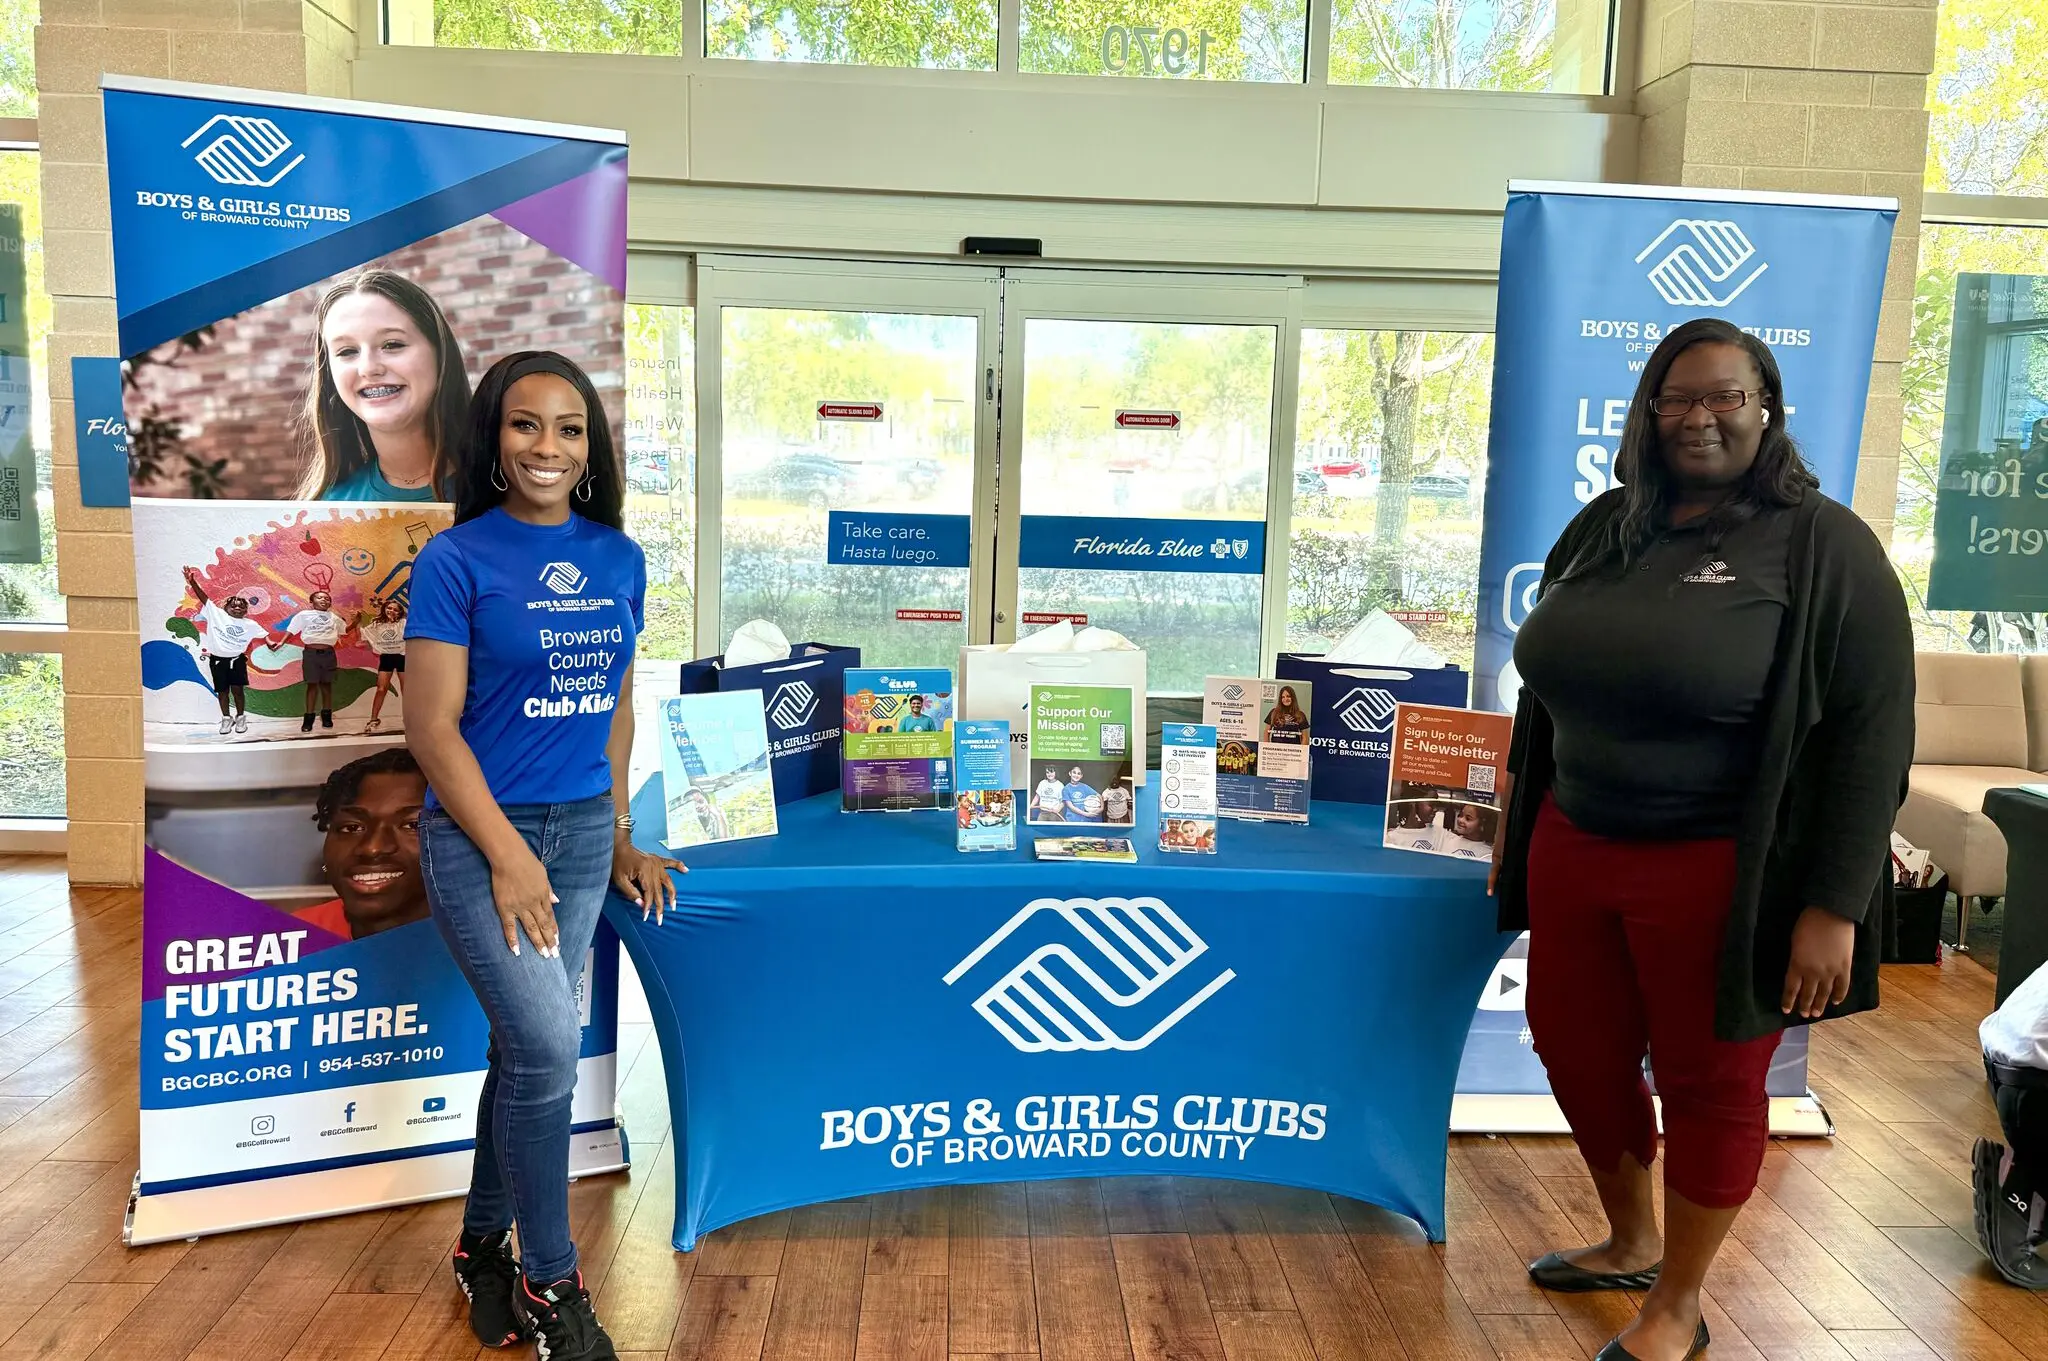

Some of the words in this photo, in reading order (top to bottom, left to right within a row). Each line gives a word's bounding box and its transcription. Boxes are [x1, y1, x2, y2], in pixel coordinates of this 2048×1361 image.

[136, 191, 193, 209] BOYS
[198, 196, 215, 211] &
[220, 198, 281, 217] GIRLS
[286, 204, 350, 222] CLUBS
[182, 211, 197, 221] OF
[201, 212, 260, 226] BROWARD
[263, 217, 309, 230] COUNTY
[1580, 320, 1639, 339] BOYS
[1643, 322, 1662, 340] &
[1625, 342, 1642, 352] OF
[842, 521, 882, 538] Take
[888, 528, 930, 539] care.
[842, 544, 886, 559] Hasta
[891, 545, 939, 564] luego.
[1073, 536, 1154, 555] Florida
[1157, 538, 1204, 557] Blue
[527, 600, 552, 609] BOYS
[552, 599, 561, 607] &
[561, 599, 587, 607] GIRLS
[588, 598, 615, 606] CLUBS
[1428, 613, 1446, 621] CLEAR
[539, 624, 623, 649] Broward
[549, 649, 616, 670] County
[550, 672, 607, 693] Needs
[524, 696, 577, 718] Club
[578, 693, 616, 714] Kids
[1037, 706, 1086, 719] Support
[1089, 707, 1112, 718] Our
[1037, 719, 1085, 731] Mission
[1404, 726, 1428, 739] Sign
[1431, 729, 1445, 741] Up
[1448, 732, 1463, 741] for
[1465, 734, 1486, 744] Our
[773, 740, 782, 751] &
[783, 734, 810, 749] GIRLS
[812, 727, 840, 742] CLUBS
[1338, 739, 1349, 748] &
[1351, 740, 1389, 751] GIRLS
[1403, 738, 1498, 760] E-Newsletter
[775, 747, 801, 758] BROWARD
[802, 742, 822, 751] COUNTY
[1172, 749, 1178, 757] 3
[1340, 750, 1375, 758] BROWARD
[165, 930, 307, 975] GREAT
[165, 968, 358, 1019] FUTURES
[164, 1016, 299, 1063] START
[312, 1003, 428, 1047] HERE.
[162, 1064, 292, 1092] BGCBC.ORG
[319, 1046, 444, 1073] 954-537-1010
[406, 1113, 461, 1126] @BGCofBroward
[820, 1099, 951, 1151] BOYS
[962, 1098, 1004, 1135] &
[1015, 1094, 1159, 1131] GIRLS
[1172, 1095, 1328, 1141] CLUBS
[320, 1124, 378, 1137] @BGCofBroward
[235, 1136, 291, 1149] @BGCofBroward
[890, 1141, 933, 1169] OF
[943, 1131, 1111, 1163] BROWARD
[1121, 1131, 1256, 1161] COUNTY
